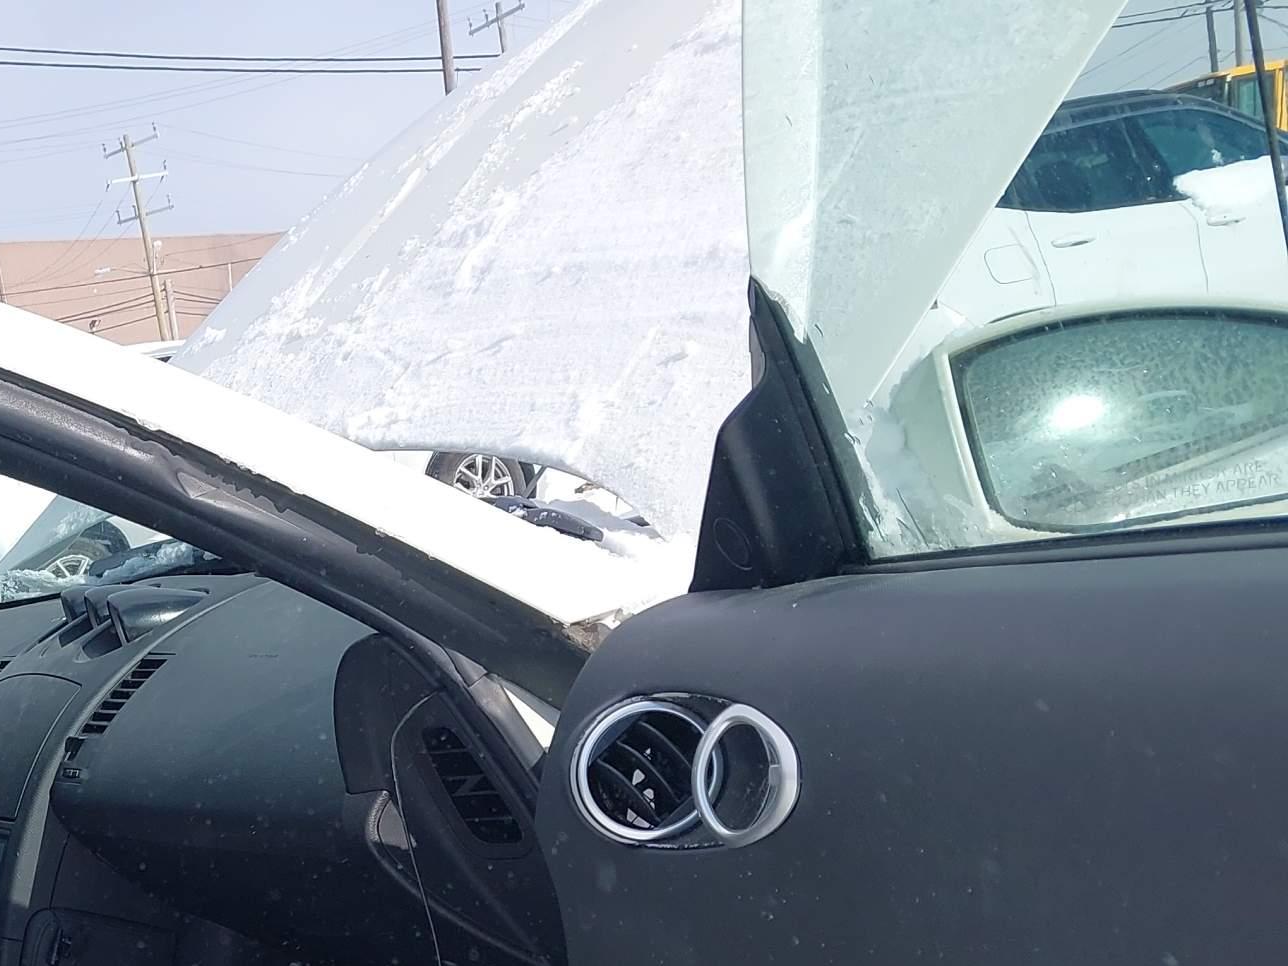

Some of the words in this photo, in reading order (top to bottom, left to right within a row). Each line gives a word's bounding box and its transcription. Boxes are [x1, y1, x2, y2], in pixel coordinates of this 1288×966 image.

[1233, 460, 1265, 475] ARE
[1172, 482, 1210, 498] THEY
[1216, 472, 1280, 493] APPEAR
